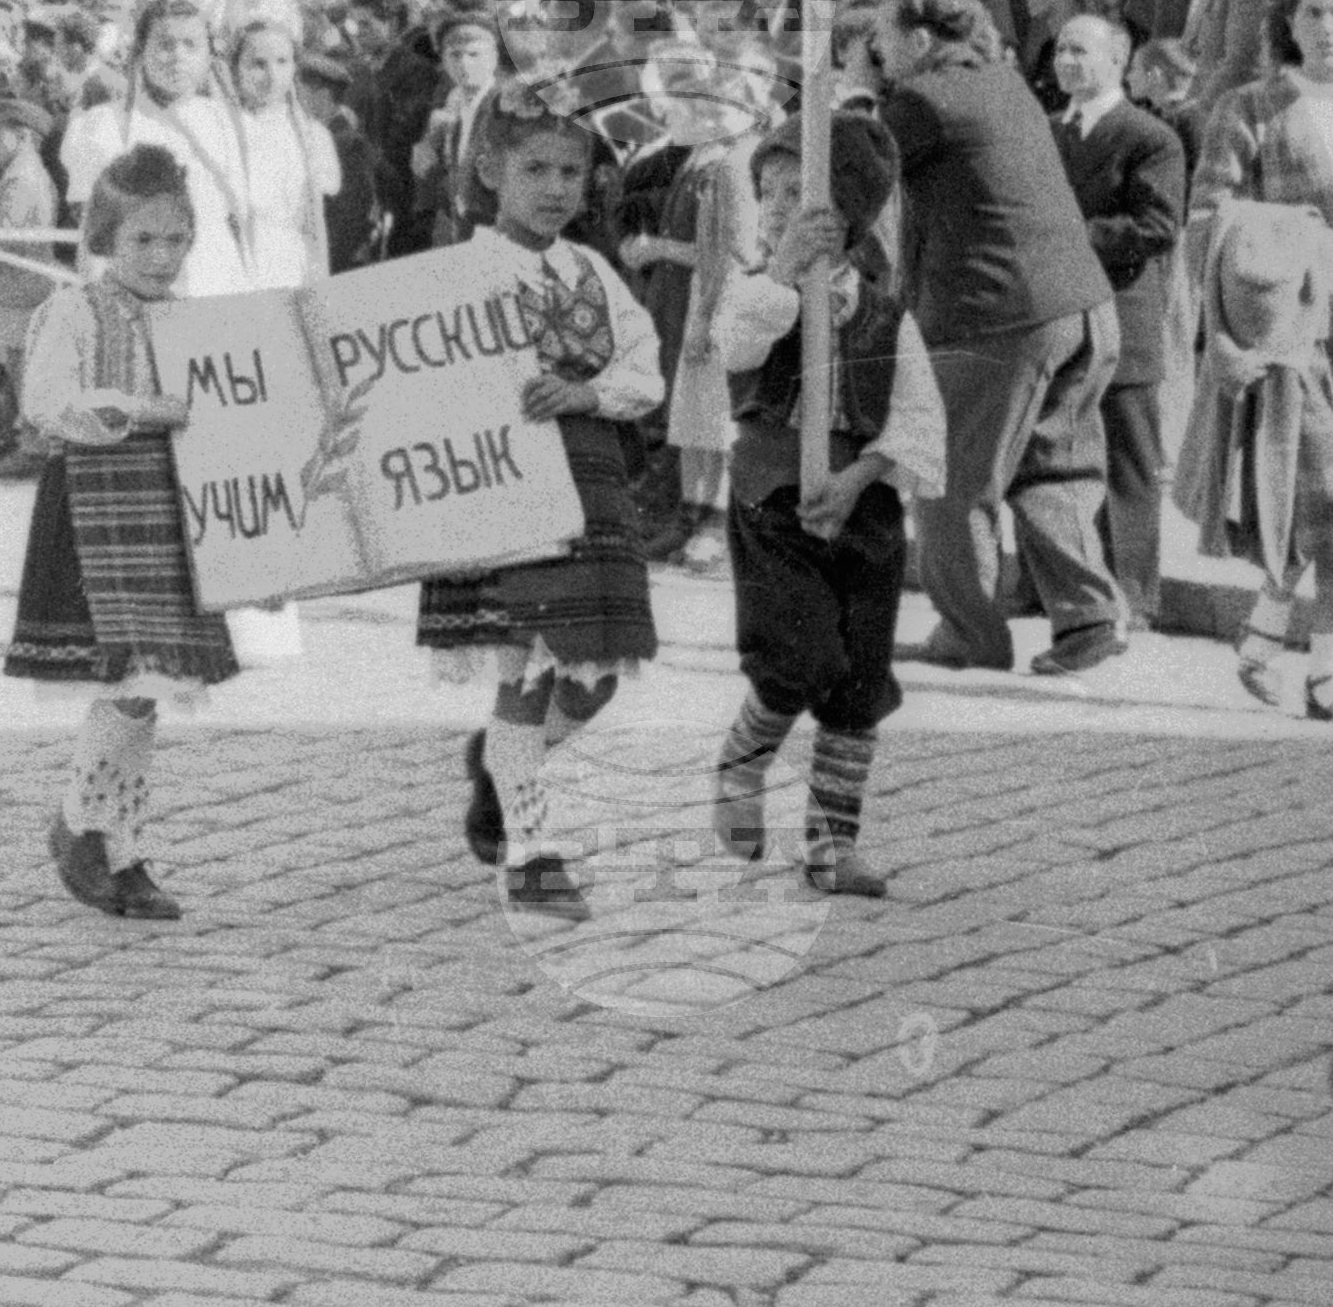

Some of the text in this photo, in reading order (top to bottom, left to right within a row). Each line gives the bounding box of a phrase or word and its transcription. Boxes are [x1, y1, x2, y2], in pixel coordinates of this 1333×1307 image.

[186, 347, 268, 407] МЫ
[330, 290, 535, 387] РУССКИЙ
[181, 471, 303, 545] УЧИМ
[380, 424, 523, 512] ЯЗЫК
